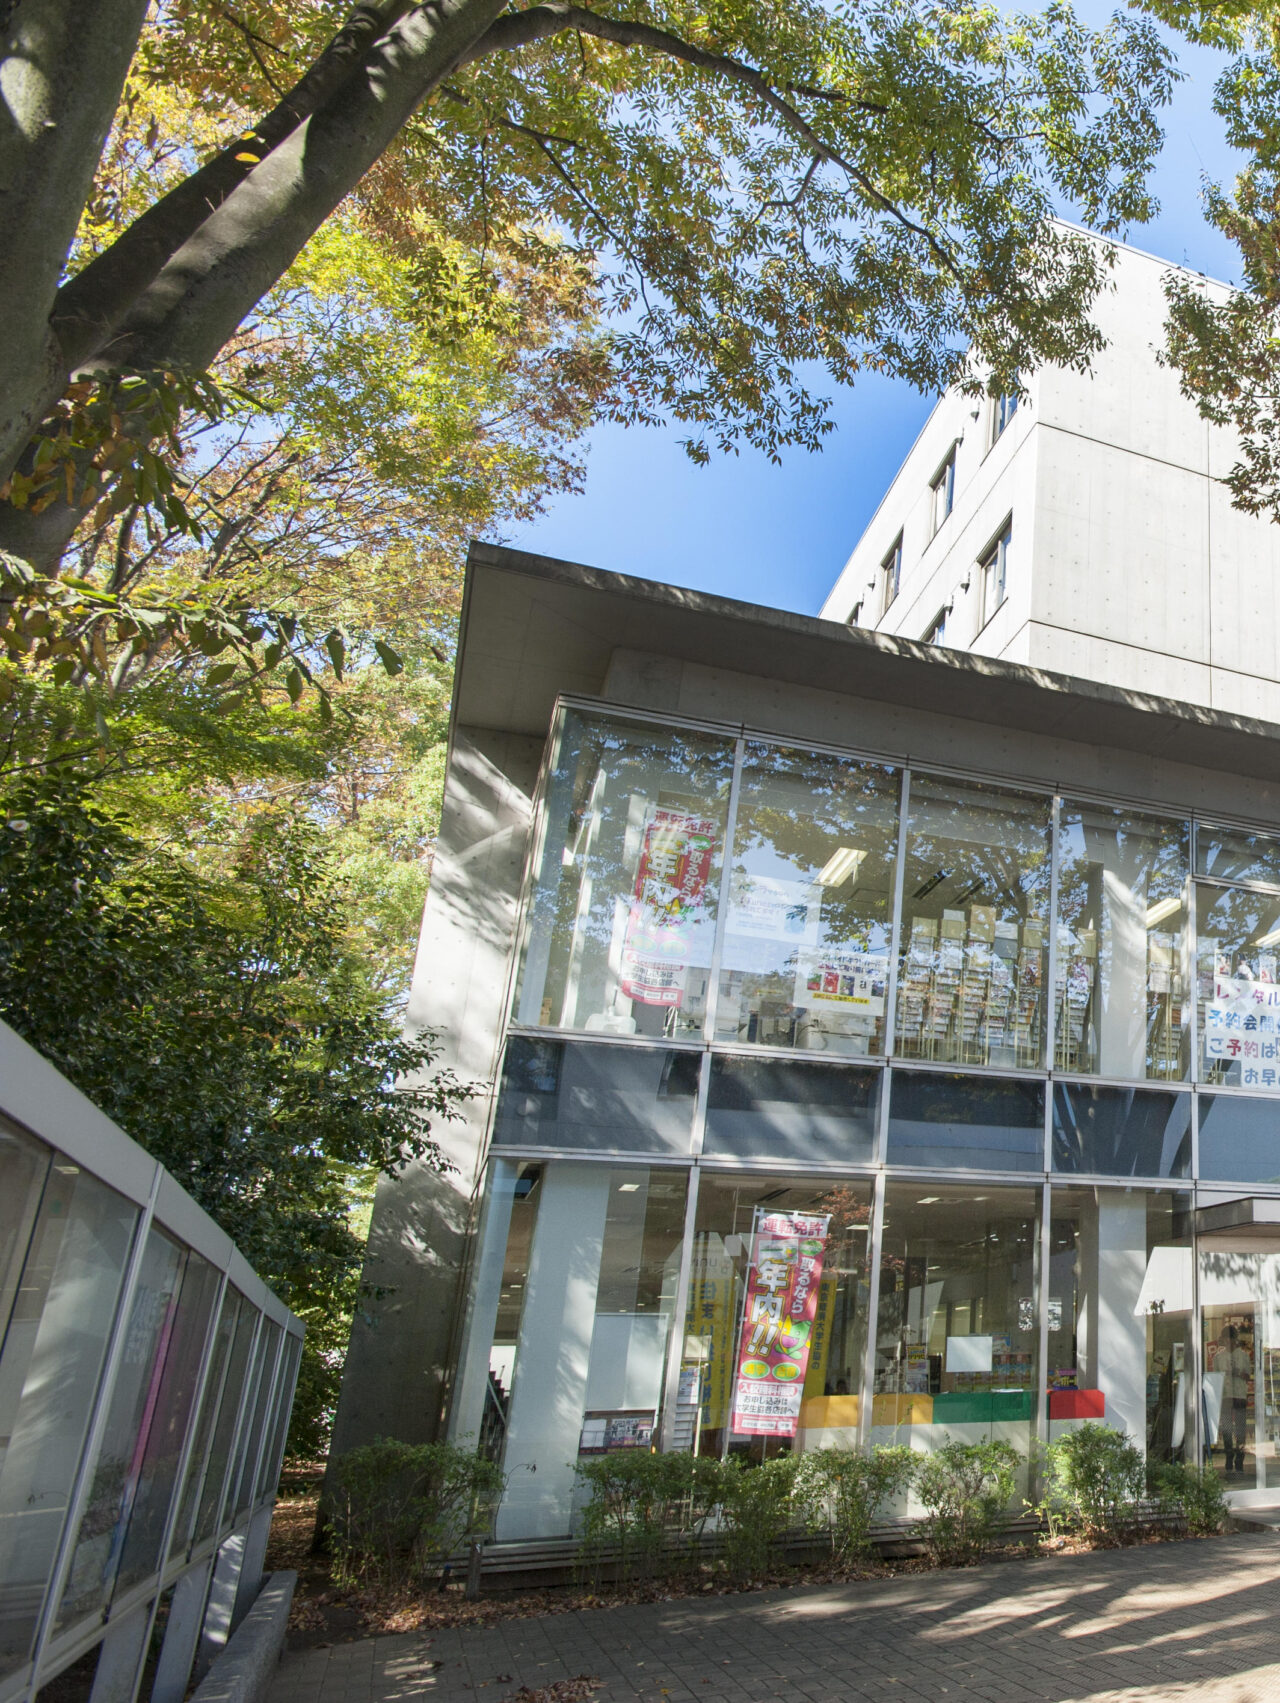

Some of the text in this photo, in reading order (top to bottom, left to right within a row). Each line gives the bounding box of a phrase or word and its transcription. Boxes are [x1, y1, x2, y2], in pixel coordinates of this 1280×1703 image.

[1209, 1037, 1276, 1059] ご予約は
[763, 1218, 824, 1238] 運転免許
[791, 1256, 816, 1315] 取るなら
